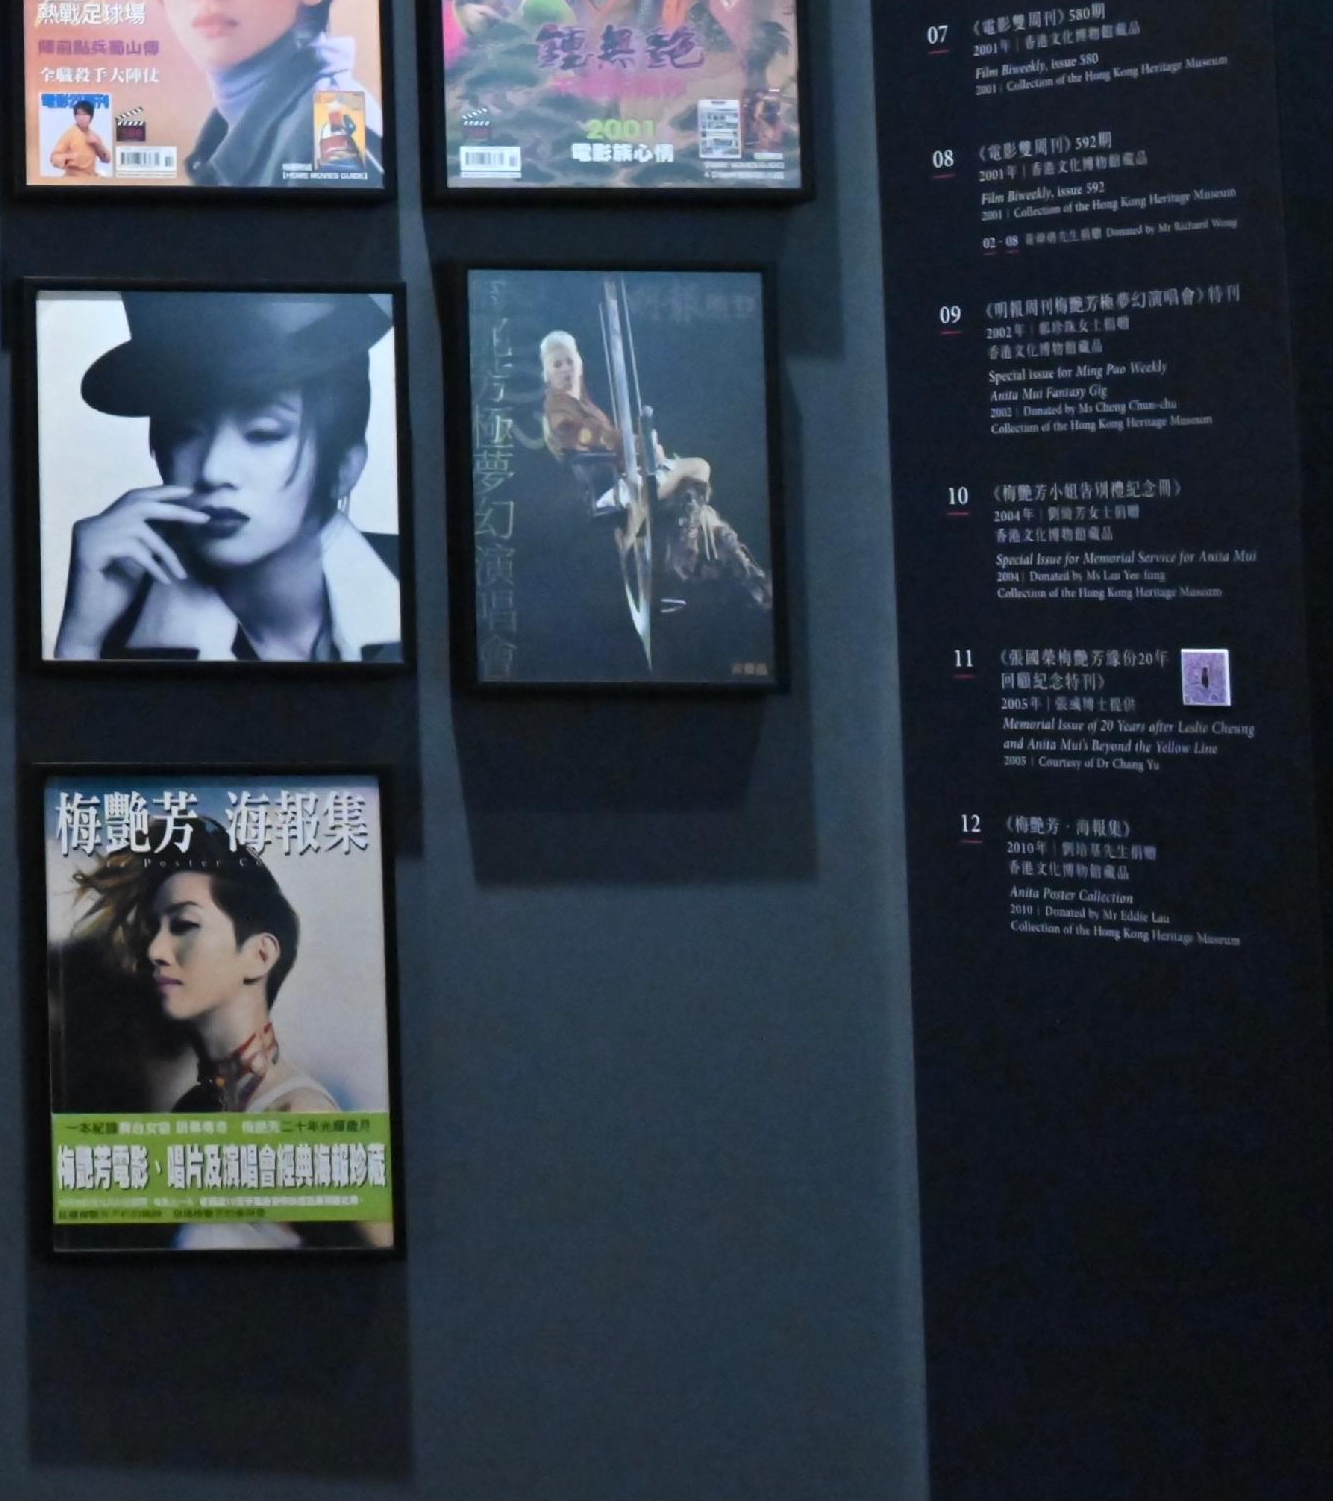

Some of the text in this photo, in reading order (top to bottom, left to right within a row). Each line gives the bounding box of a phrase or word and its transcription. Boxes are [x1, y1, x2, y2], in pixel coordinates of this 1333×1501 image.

[927, 26, 948, 45] 07
[976, 67, 999, 79] Film
[1051, 55, 1076, 69] issue
[1079, 53, 1098, 66] 580
[586, 118, 655, 140] 2001
[933, 149, 954, 169] 08
[940, 305, 961, 324] 09
[989, 369, 1026, 385] Special
[1057, 367, 1072, 378] for
[1076, 365, 1103, 380] Ming
[1106, 363, 1126, 376] Pao
[1131, 359, 1168, 375] Weekly
[948, 487, 968, 505] 10
[996, 550, 1257, 567] Special Issue for Memorial Service for Anita Mui
[954, 650, 973, 668] 11
[1002, 717, 1255, 738] Memorial Issue of 20 Years after Leslie Cheung
[56, 791, 369, 857] 梅艷芳 海報集
[961, 814, 980, 833] 12
[1010, 886, 1133, 904] Anita Poster Collection
